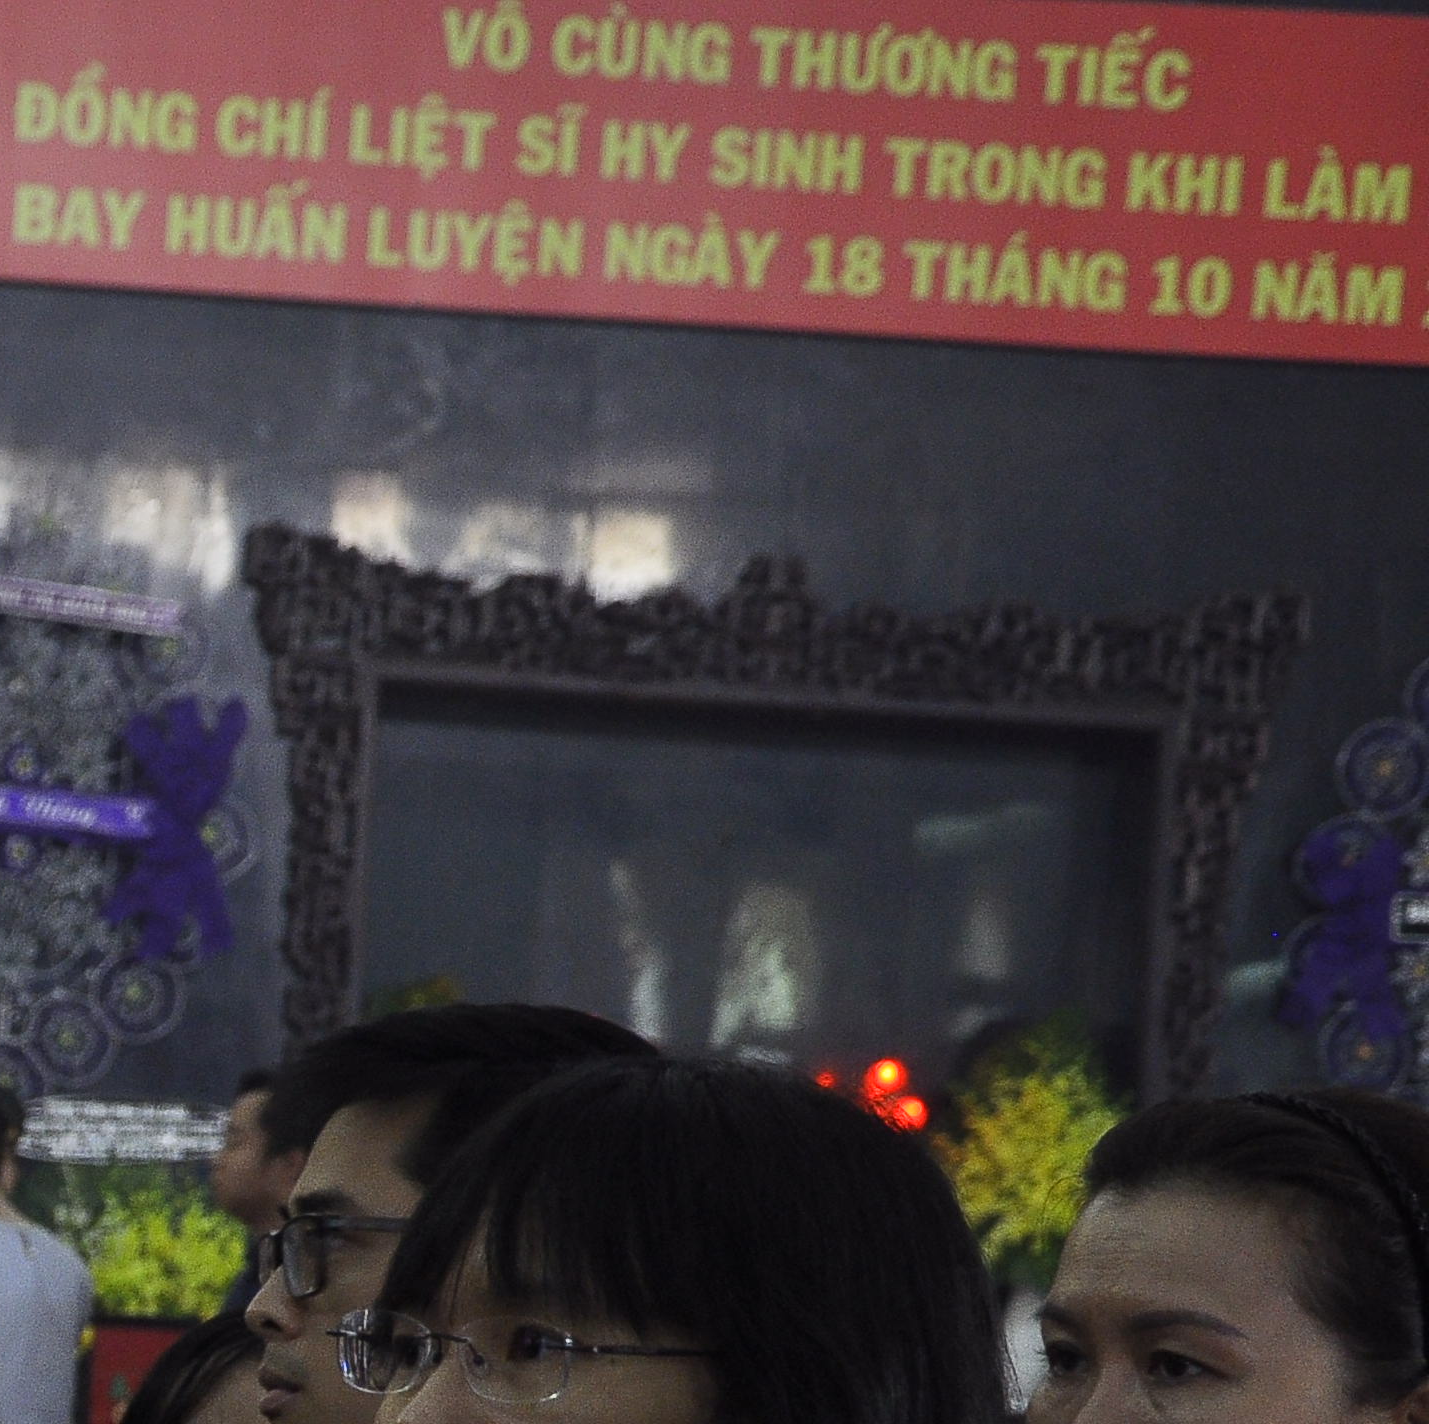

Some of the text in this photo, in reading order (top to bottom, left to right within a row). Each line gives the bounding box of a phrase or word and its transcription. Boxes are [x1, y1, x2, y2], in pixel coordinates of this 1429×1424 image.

[442, 0, 1193, 112] VÔ CÙNG THƯƠNG TIẾC
[14, 60, 200, 155] ĐỒNG
[216, 84, 335, 163] CHÍ
[348, 93, 497, 180] LIỆT
[516, 102, 588, 178] SĨ
[600, 118, 692, 183] HY
[710, 125, 865, 196] SINH
[885, 136, 1107, 209] TRONG
[1125, 150, 1244, 217] KHI
[1264, 145, 1413, 225] LÀM
[12, 178, 1406, 326] BAY HUẤN LUYỆN NGÀY 18 THÁNG 10 NĂM
